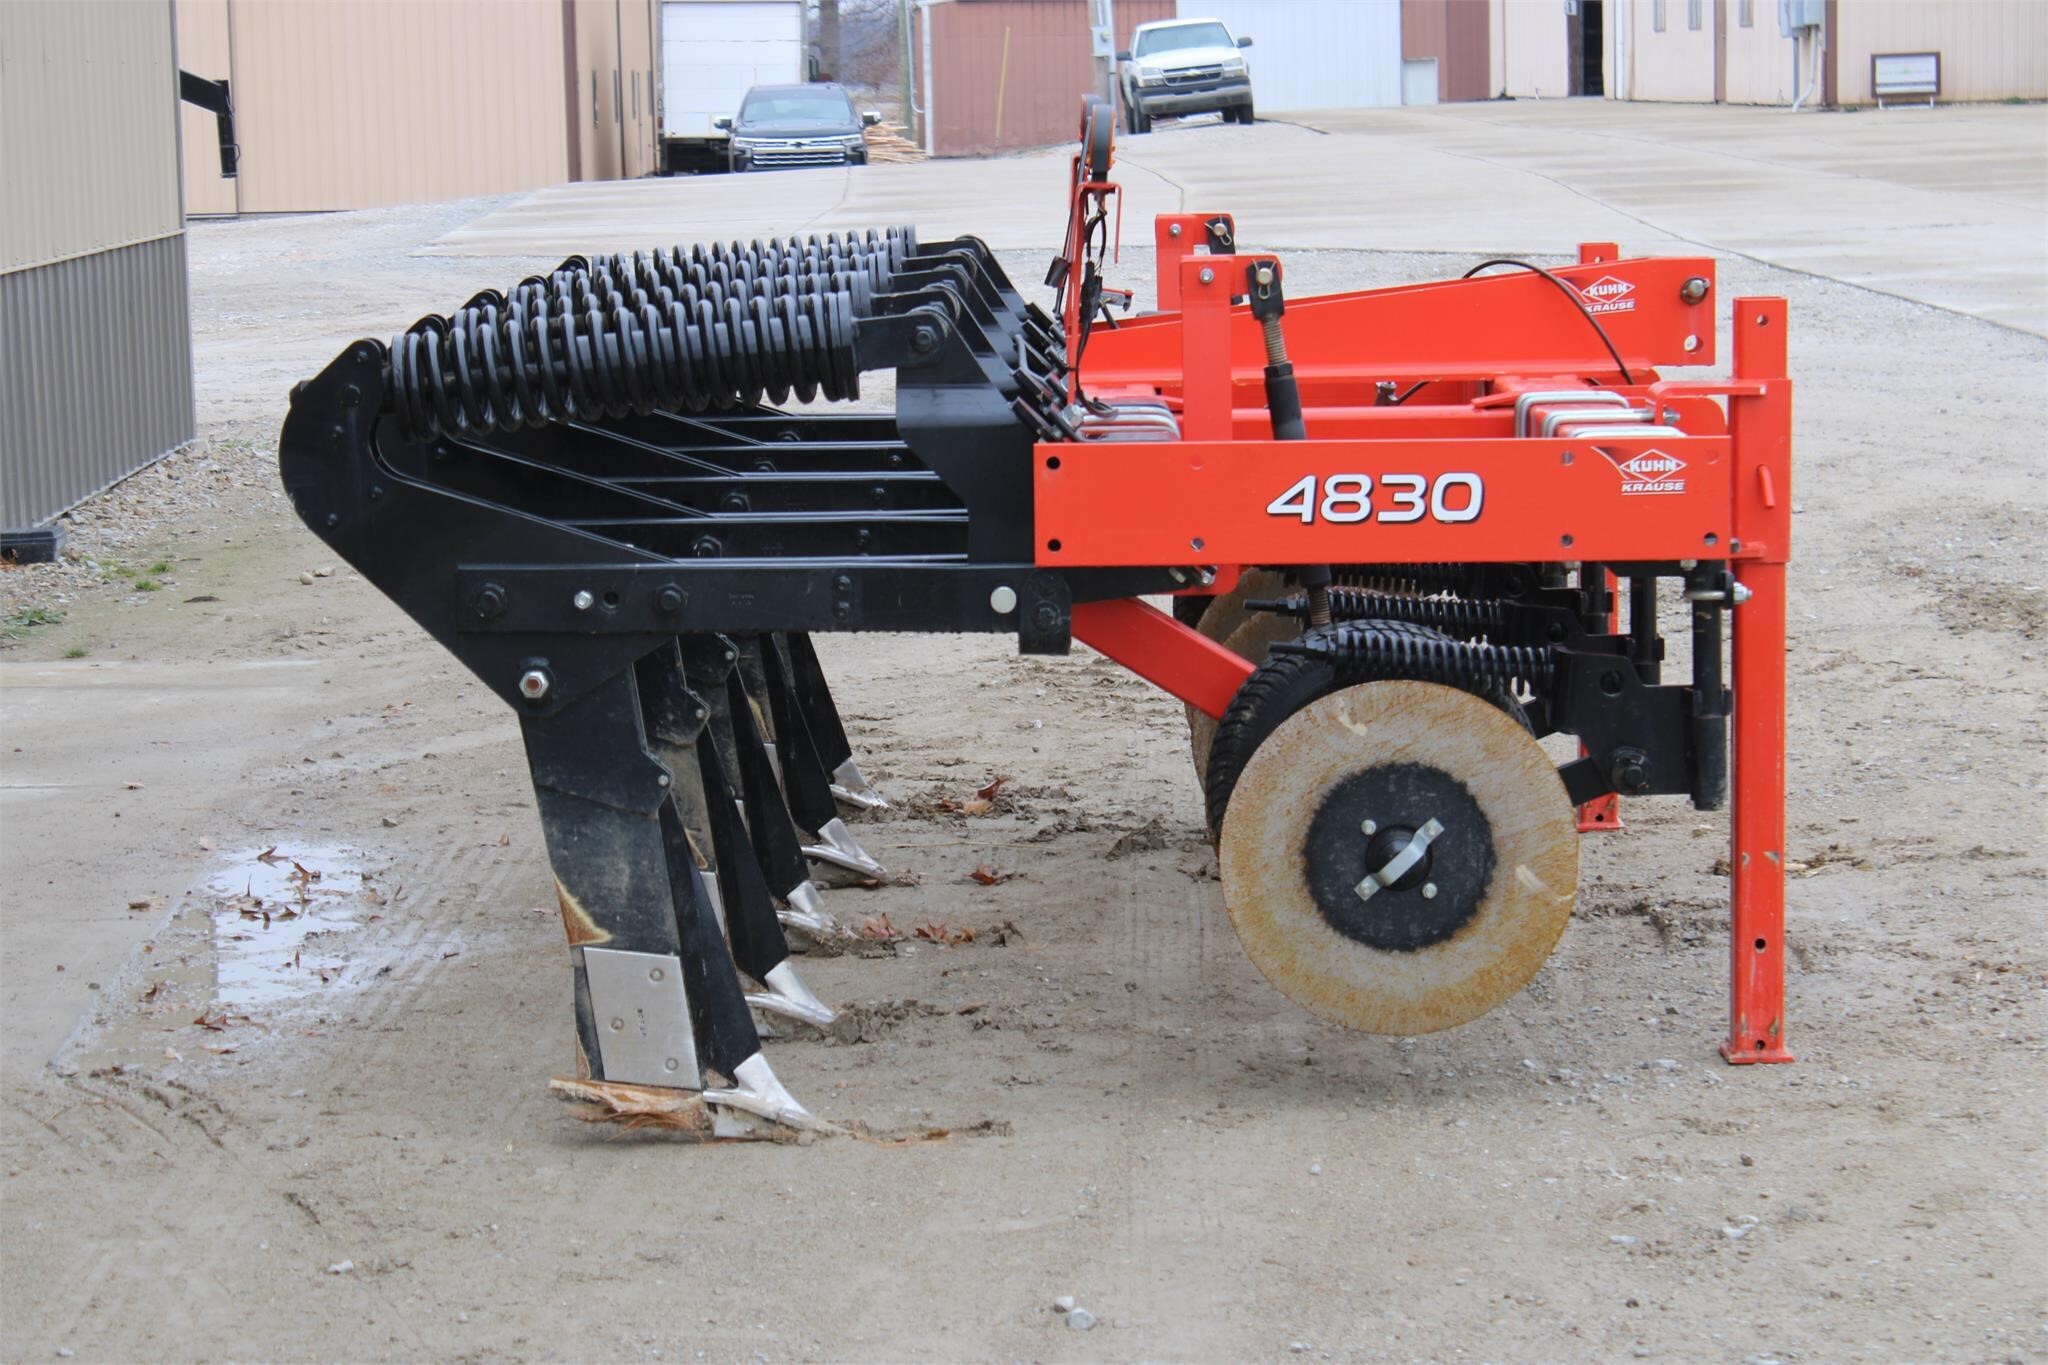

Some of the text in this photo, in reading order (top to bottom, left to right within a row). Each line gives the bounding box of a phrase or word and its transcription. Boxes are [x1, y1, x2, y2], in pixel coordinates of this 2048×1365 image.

[1589, 284, 1628, 297] KUHN
[1584, 301, 1635, 313] KRAUSE
[1629, 460, 1677, 472] KUHN
[1621, 482, 1685, 492] KRAUSE
[1266, 472, 1484, 524] 4830
